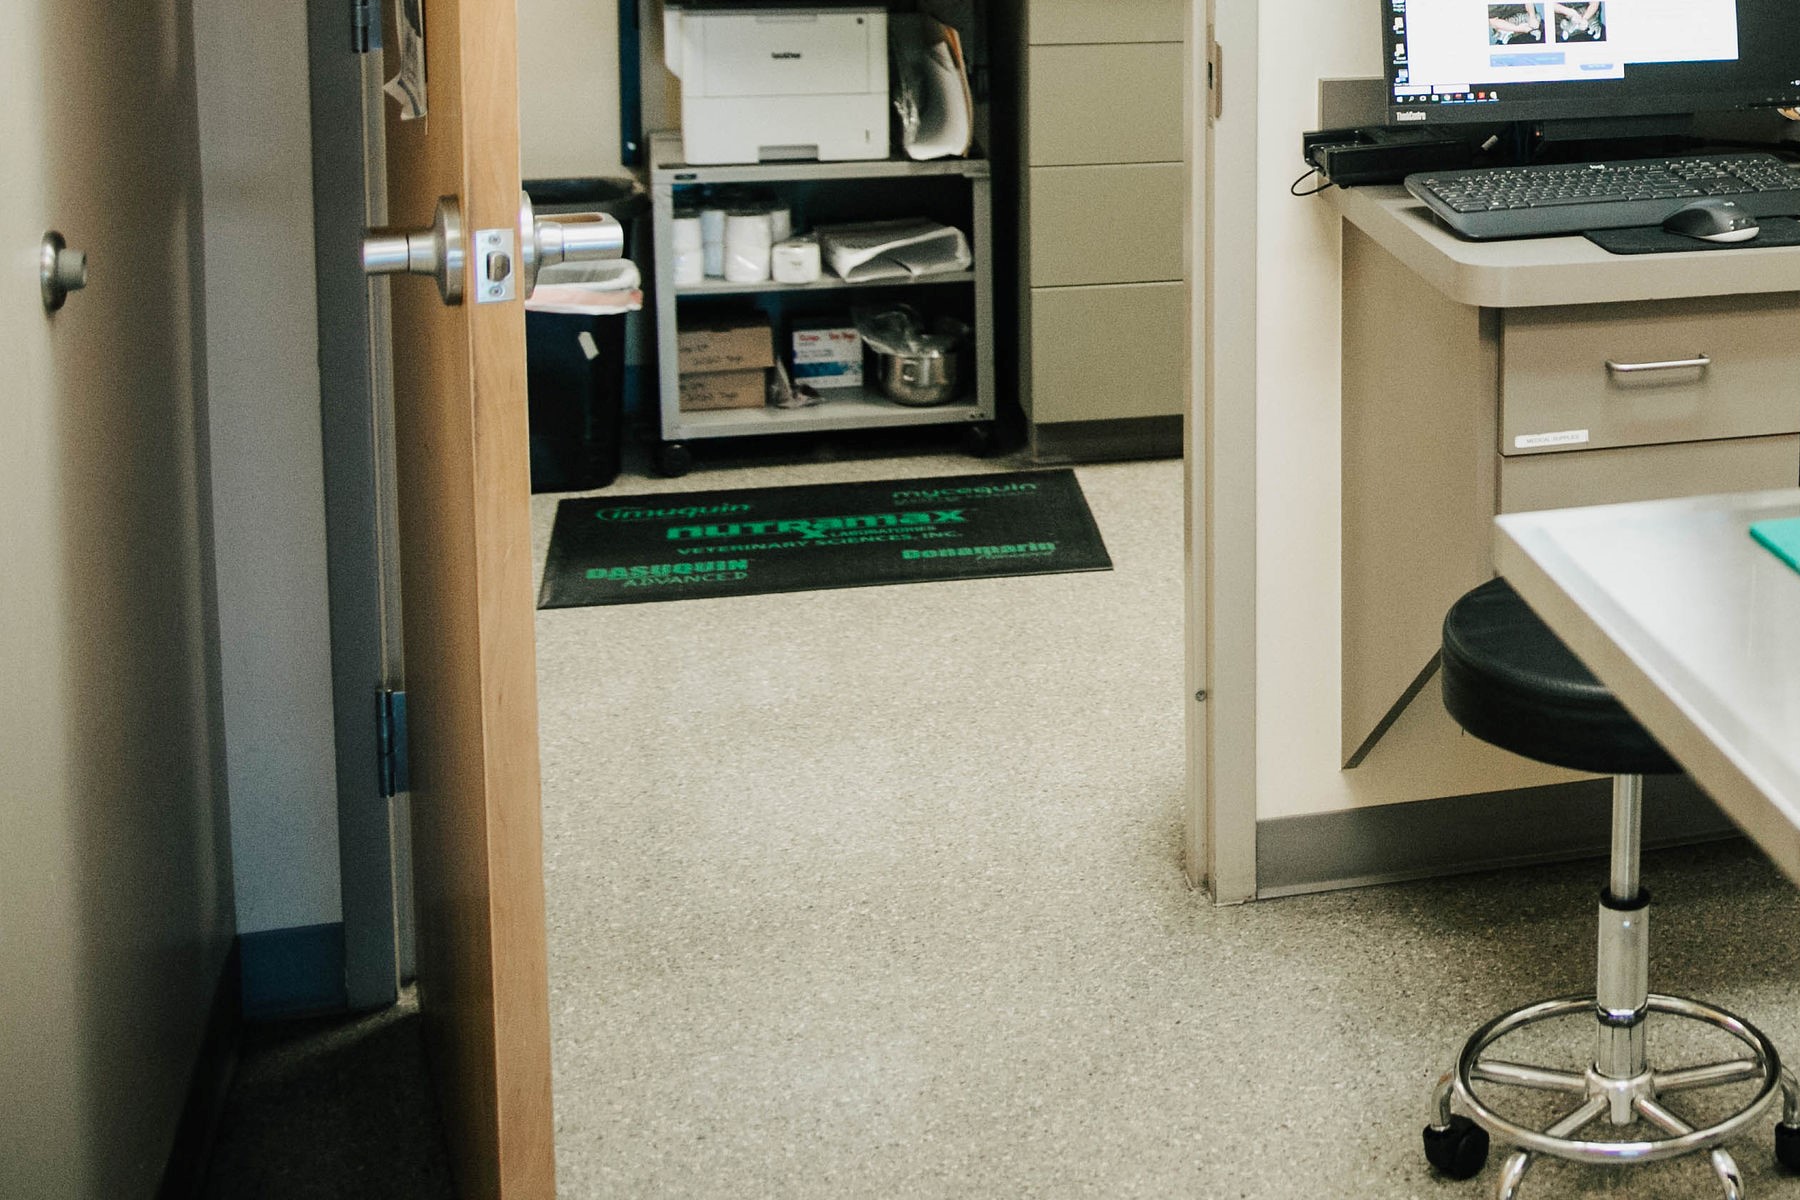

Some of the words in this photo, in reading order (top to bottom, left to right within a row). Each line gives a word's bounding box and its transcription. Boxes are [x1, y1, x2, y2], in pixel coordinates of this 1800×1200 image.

[676, 540, 809, 556] VETERINARY
[921, 530, 965, 540] INC.
[624, 571, 748, 588] ADVANCED
